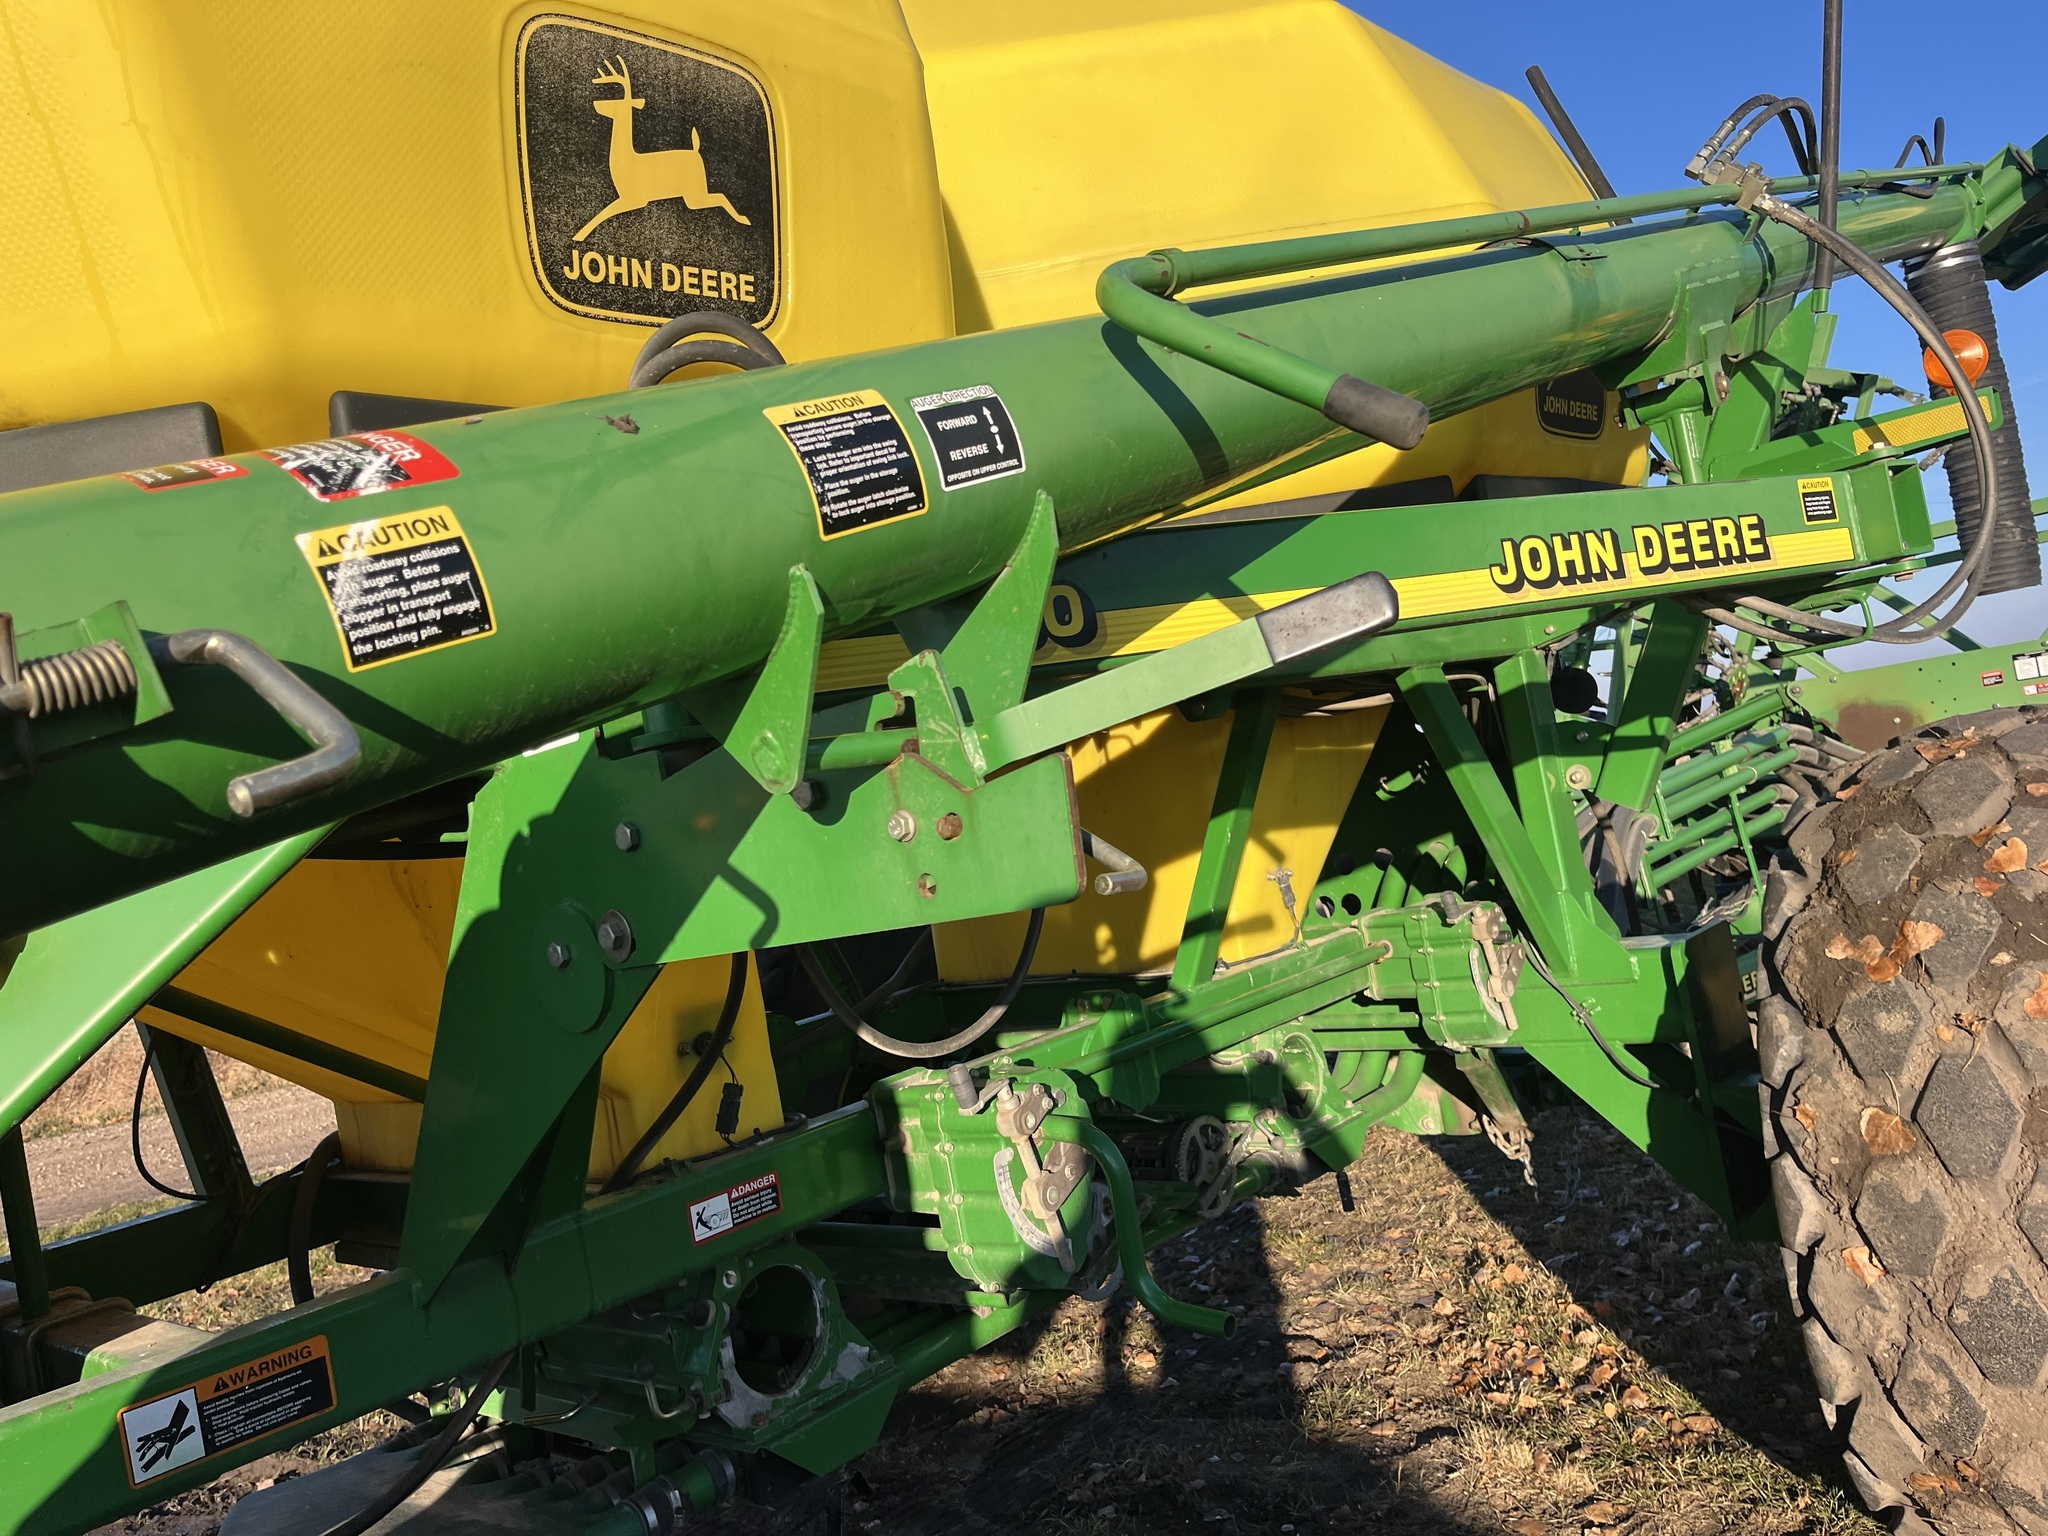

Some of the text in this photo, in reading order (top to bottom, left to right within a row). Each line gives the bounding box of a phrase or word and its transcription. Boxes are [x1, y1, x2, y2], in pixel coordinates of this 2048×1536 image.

[563, 250, 756, 303] JOHN DEERE
[803, 396, 864, 415] CAUTION
[911, 386, 994, 408] AUGER DIRECTION
[1543, 395, 1598, 421] JOHN DEERE
[937, 415, 978, 431] FORWARD
[949, 443, 989, 461] REVERSE
[947, 459, 1019, 482] OPPOSITE ON UPPER CONTROL
[1806, 481, 1829, 489] CAUTION
[361, 556, 408, 573] roadway
[409, 545, 460, 563] collisions
[1489, 513, 1771, 594] JOHN DEERE
[362, 573, 399, 588] auger.
[402, 564, 440, 579] Before
[411, 579, 440, 595] place
[441, 571, 470, 586] auger
[343, 590, 452, 623] hopper in transport
[349, 600, 480, 642] position and fully engage
[353, 625, 442, 655] the locking pin.
[738, 1174, 776, 1195] DANGER
[229, 1345, 313, 1385] WARNING
